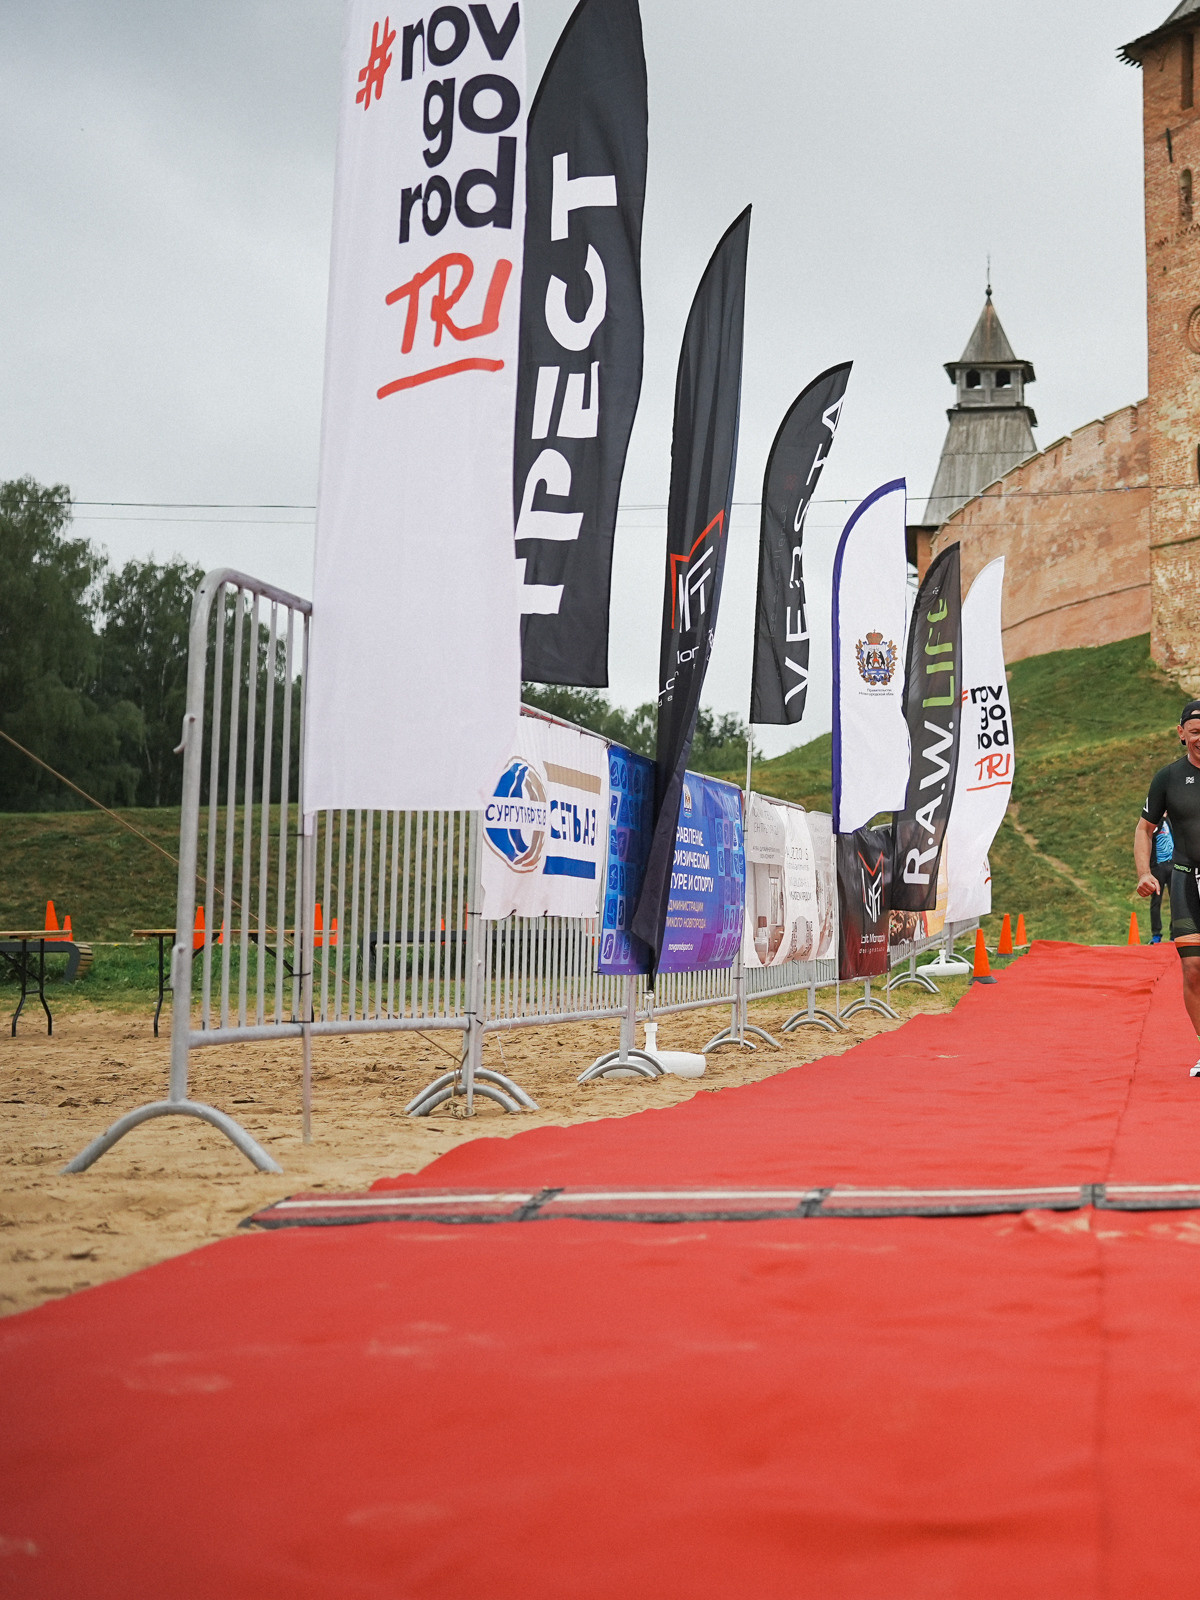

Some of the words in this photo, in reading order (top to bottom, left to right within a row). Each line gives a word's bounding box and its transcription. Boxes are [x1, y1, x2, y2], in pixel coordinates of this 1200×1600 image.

[355, 2, 521, 111] #nov
[422, 73, 521, 168] go
[398, 136, 518, 245] rod
[385, 252, 514, 355] TRI
[903, 719, 954, 886] R.A.W.
[974, 753, 1010, 780] TRI
